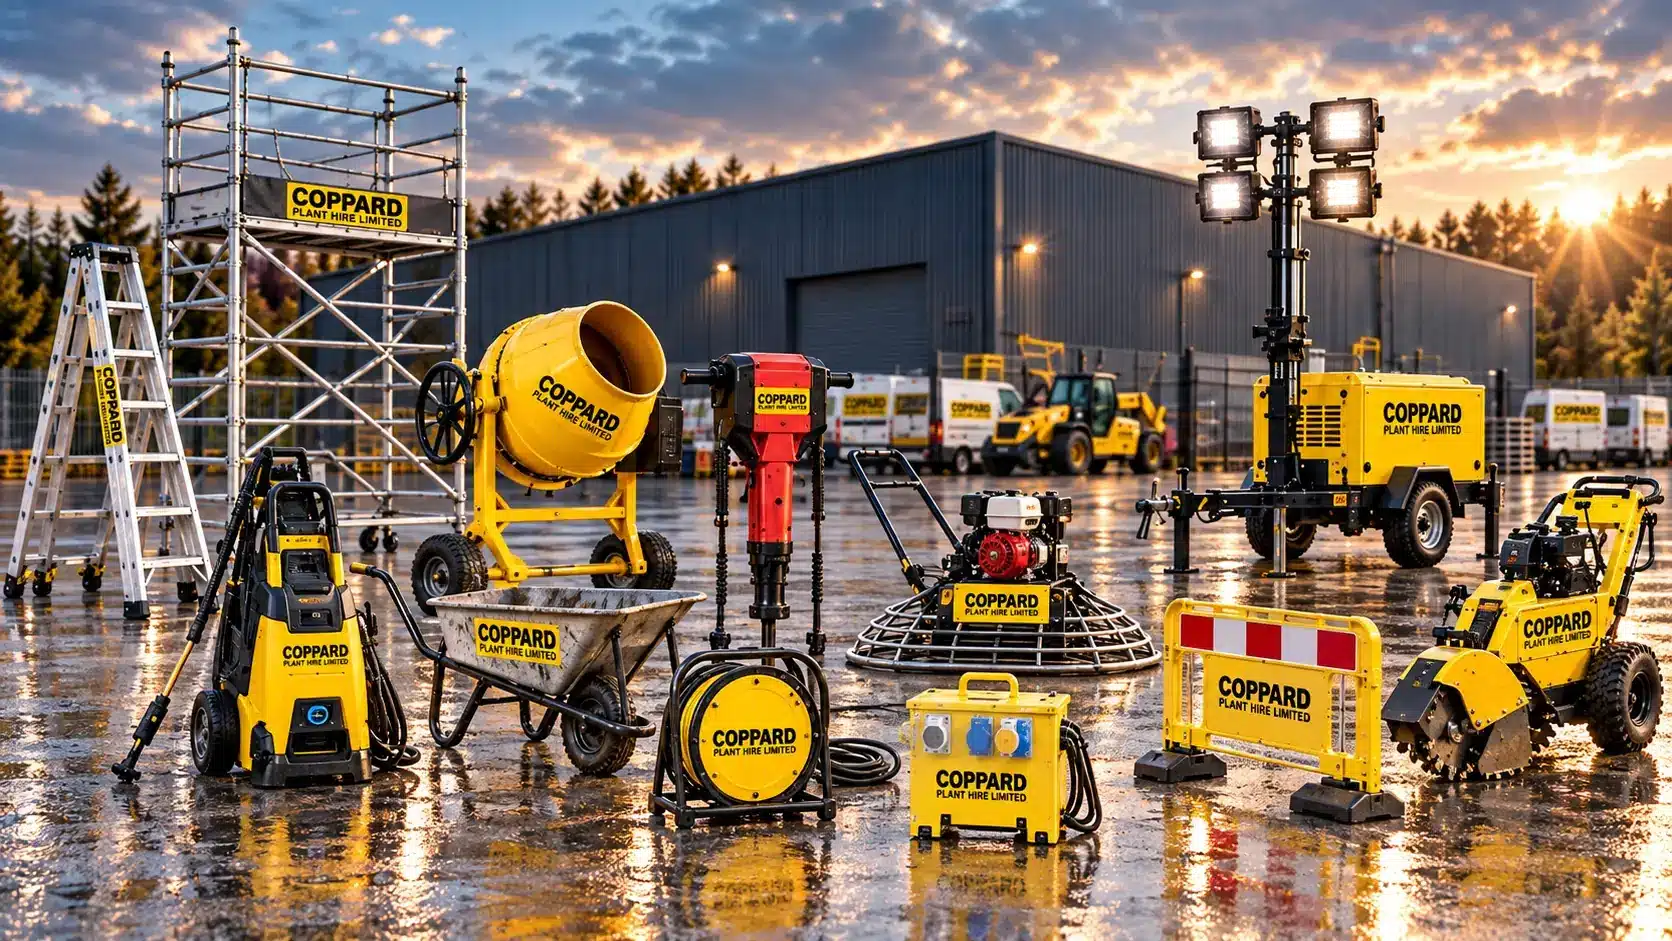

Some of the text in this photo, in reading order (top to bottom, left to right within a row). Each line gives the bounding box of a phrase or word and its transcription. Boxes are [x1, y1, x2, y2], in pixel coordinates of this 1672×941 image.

[292, 187, 402, 217] COPPARD
[292, 208, 402, 227] PLANT HIRE LIMITED
[538, 375, 620, 431] COPPARD
[757, 394, 807, 404] COPPARD
[532, 390, 612, 441] PLANT HIRE LIMITED
[1383, 402, 1462, 423] COPPARD
[1383, 425, 1462, 435] PLANT HIRE LIMITED
[965, 592, 1039, 608] COPPARD
[965, 608, 989, 616] PLANT
[1010, 609, 1039, 617] LIMITED
[1523, 610, 1592, 638] COPPARD
[478, 623, 557, 649] COPPARD
[1524, 630, 1592, 649] PLANT HIRE LIMITED
[282, 644, 349, 659] COPPARD
[479, 643, 557, 661] PLANT HIRE LIMITED
[283, 659, 305, 667] PLANT
[1218, 675, 1311, 710] COPPARD
[1218, 697, 1311, 723] PLANT HIRE LIMITED
[712, 727, 797, 747] COPPARD
[713, 746, 797, 757] PLANT HIRE LIMITED
[936, 769, 1027, 791] COPPARD
[936, 789, 1027, 802] PLANT HIRE LIMITED
